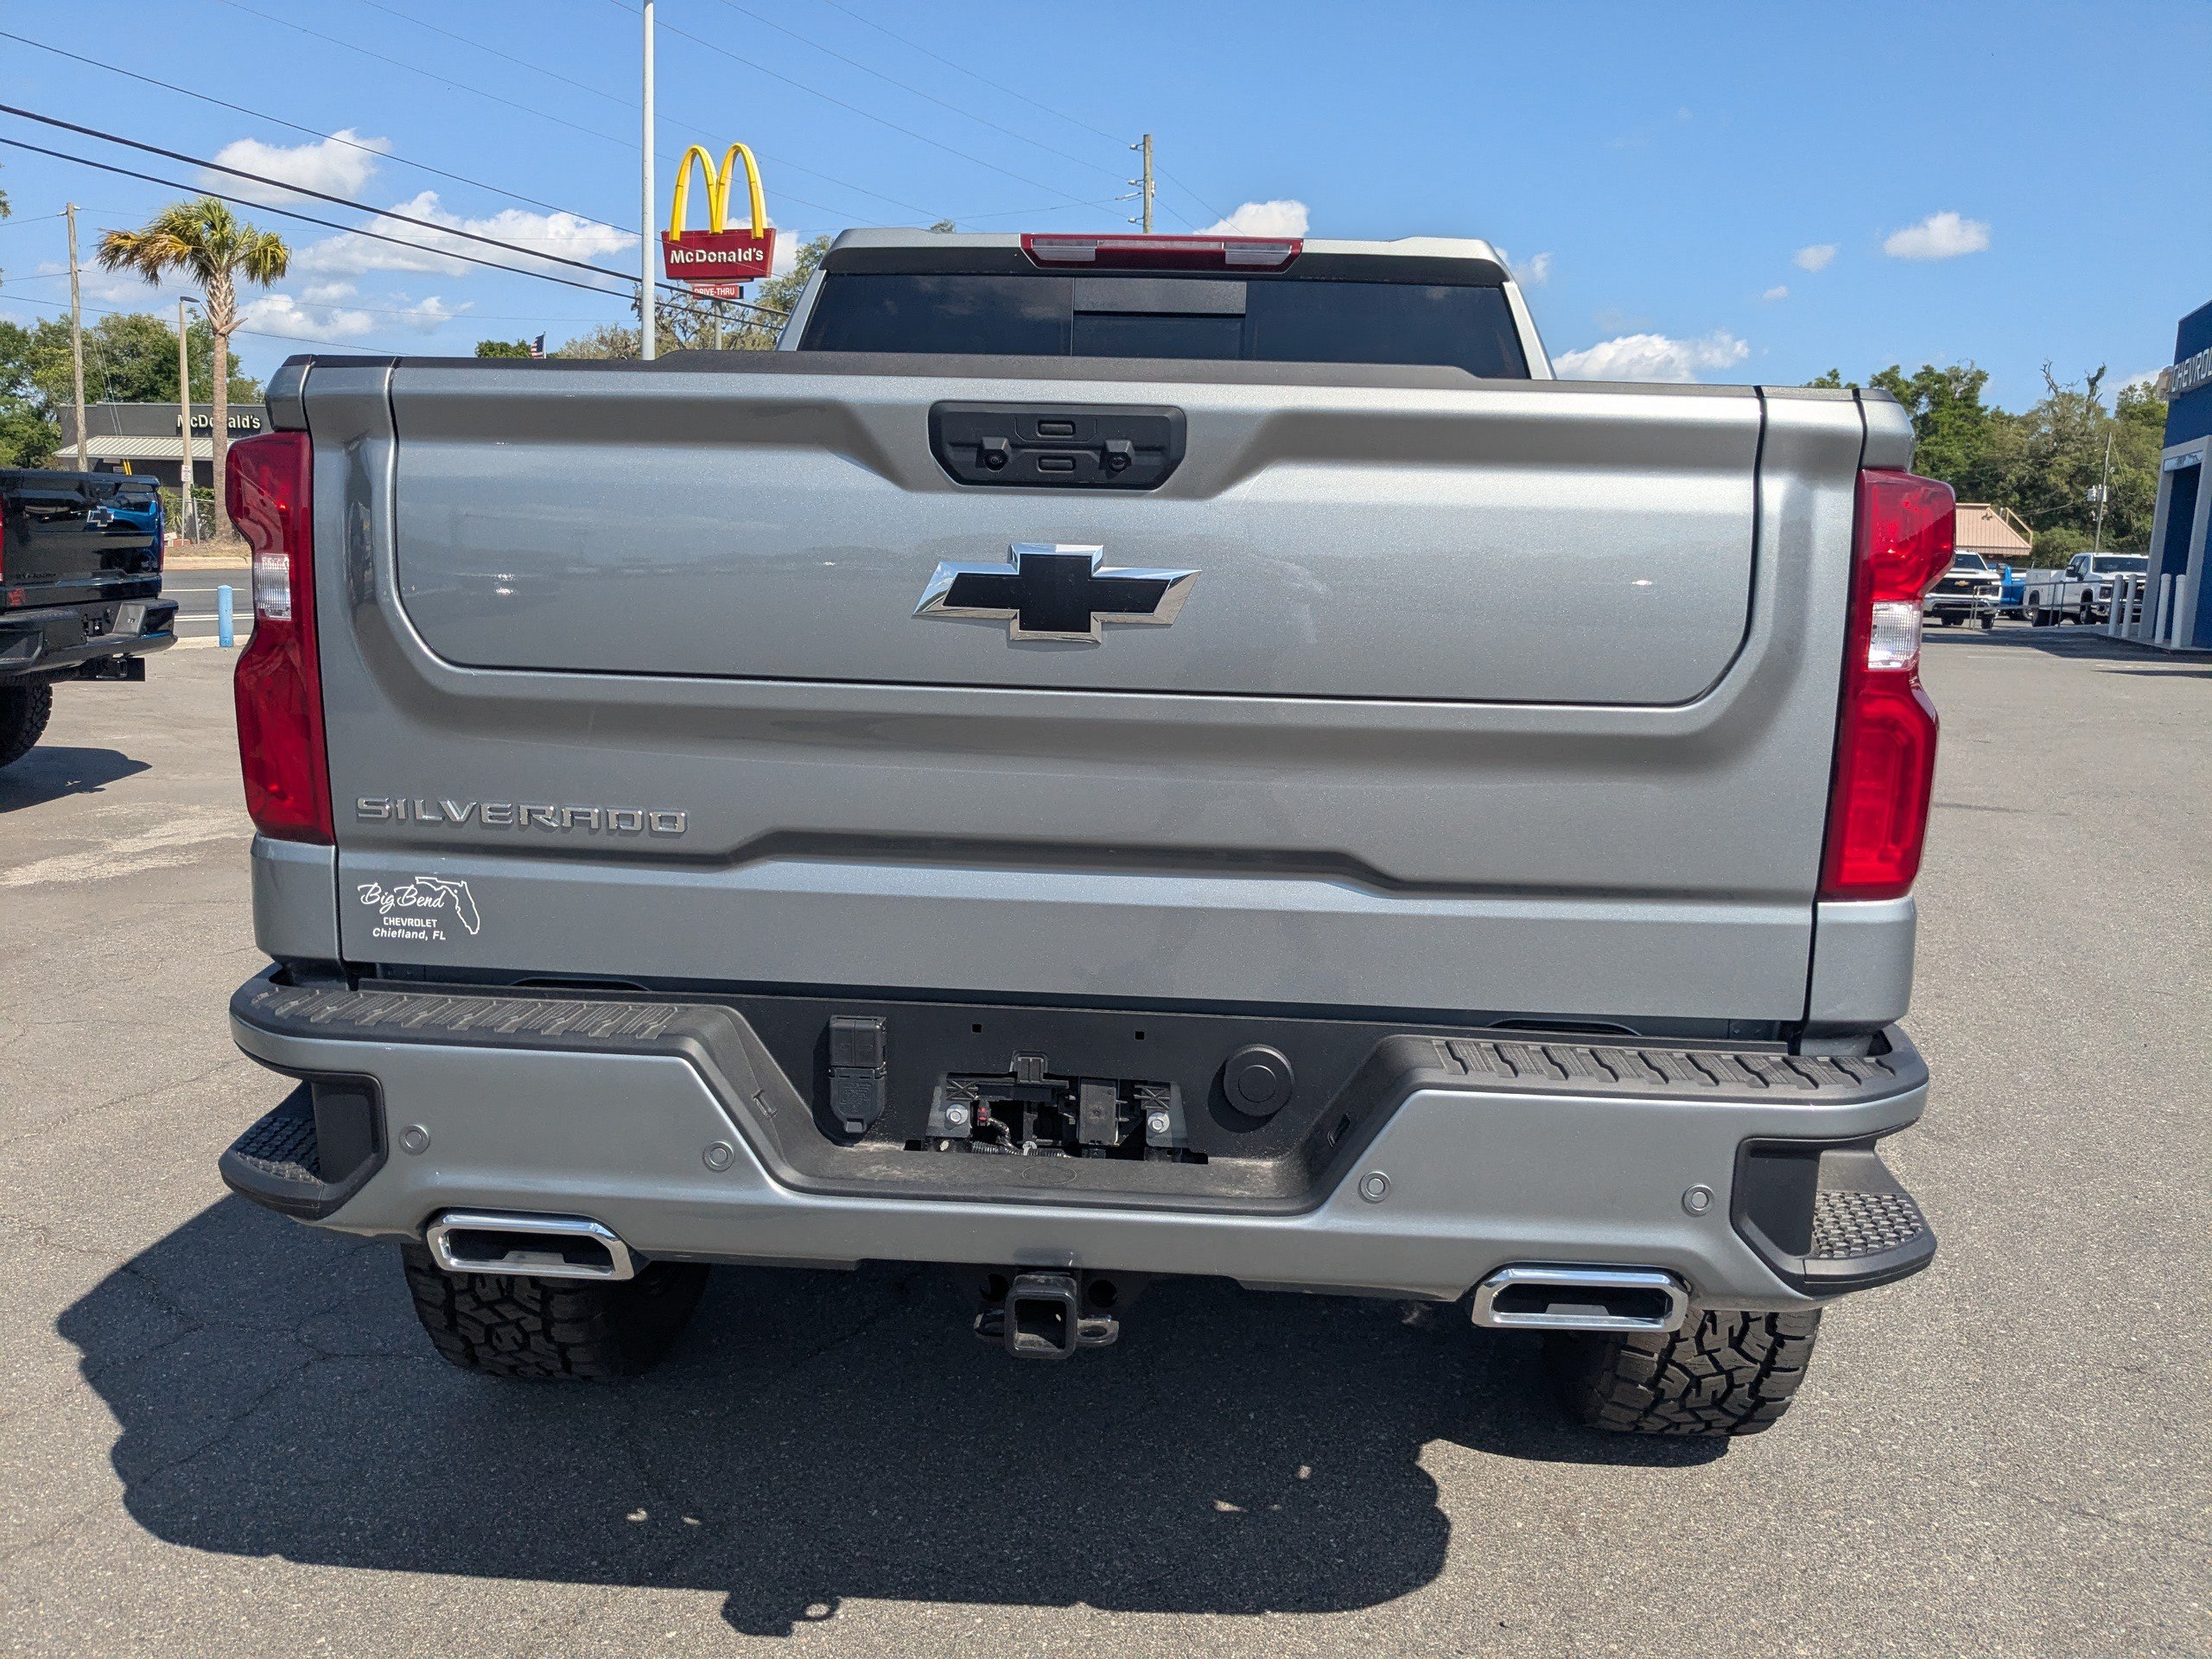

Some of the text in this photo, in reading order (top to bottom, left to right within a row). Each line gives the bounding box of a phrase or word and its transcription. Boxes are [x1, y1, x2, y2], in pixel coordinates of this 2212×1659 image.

[670, 247, 764, 264] McDonald's
[694, 287, 735, 296] DRIVE-THRU
[355, 797, 689, 833] SILVERADO
[357, 881, 447, 914] Big Bend
[383, 917, 438, 928] CHEVROLET
[372, 927, 447, 941] Chiefland, FL
